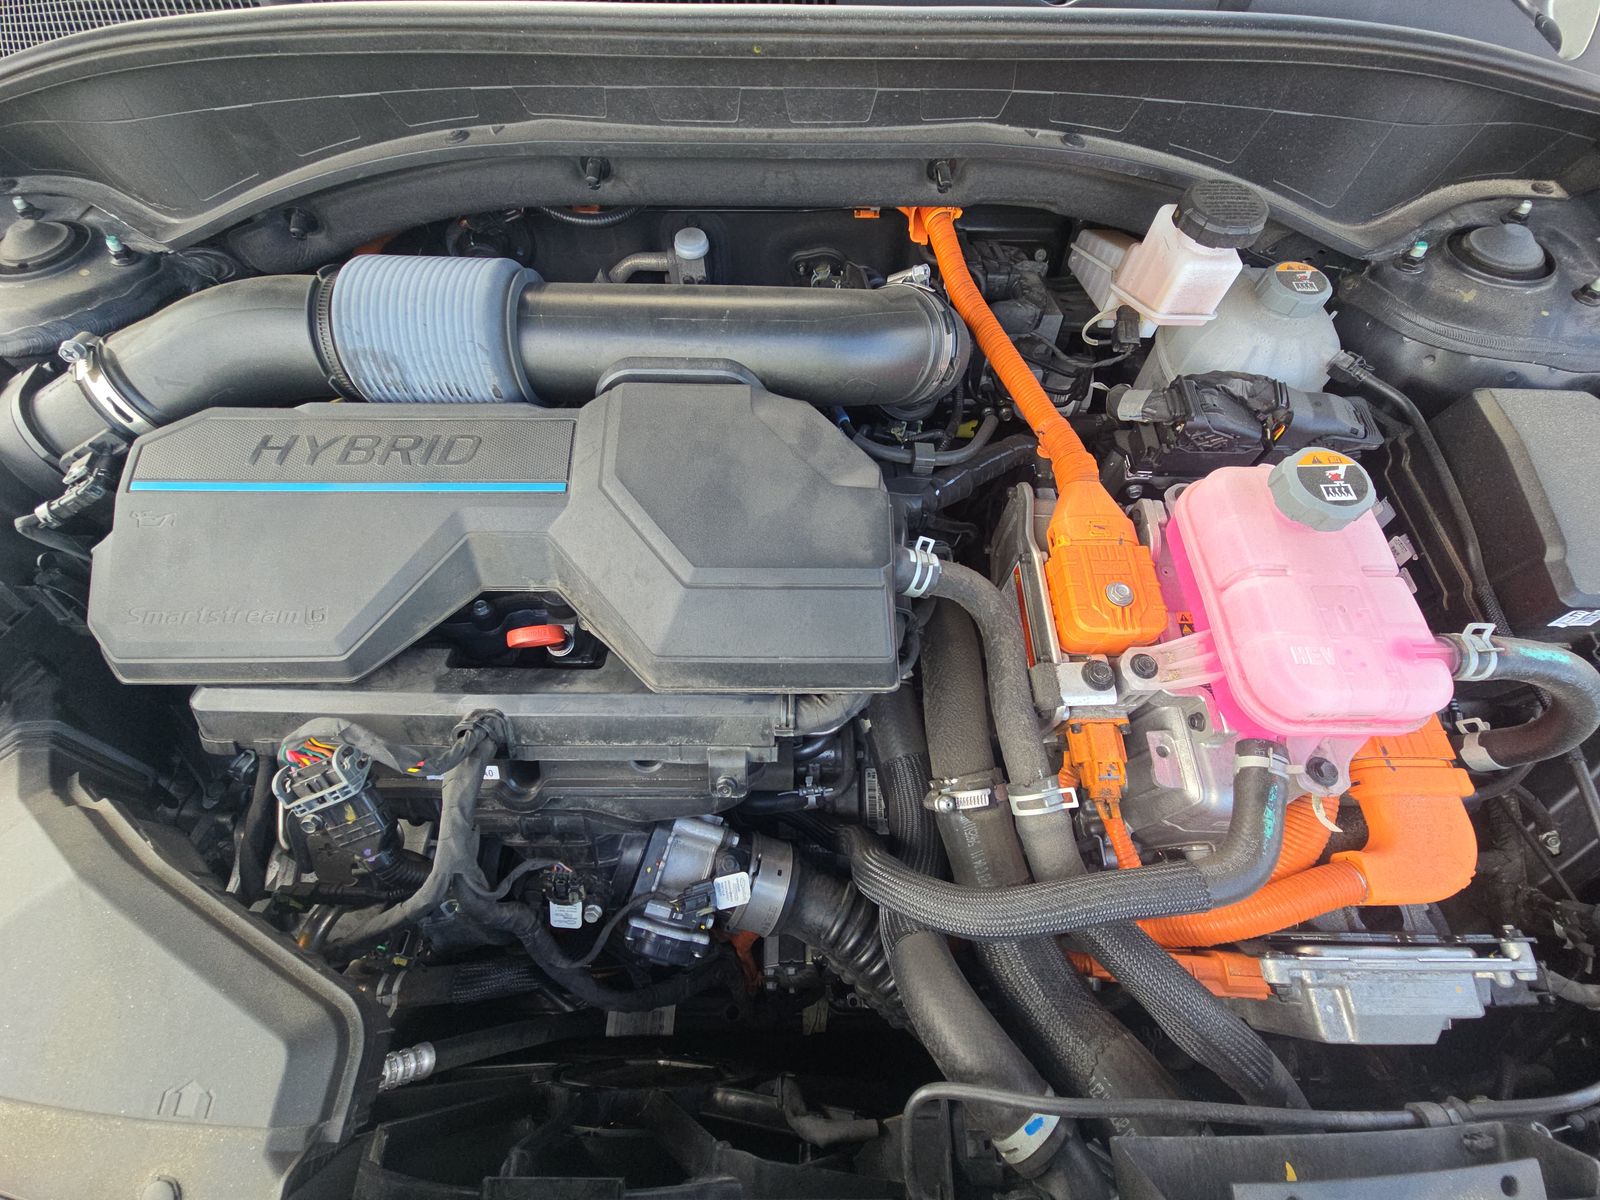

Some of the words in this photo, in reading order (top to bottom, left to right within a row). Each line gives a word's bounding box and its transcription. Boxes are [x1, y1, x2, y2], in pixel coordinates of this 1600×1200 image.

[247, 433, 483, 466] HYBRID
[126, 606, 298, 625] Smartstream
[1290, 645, 1336, 666] HEV
